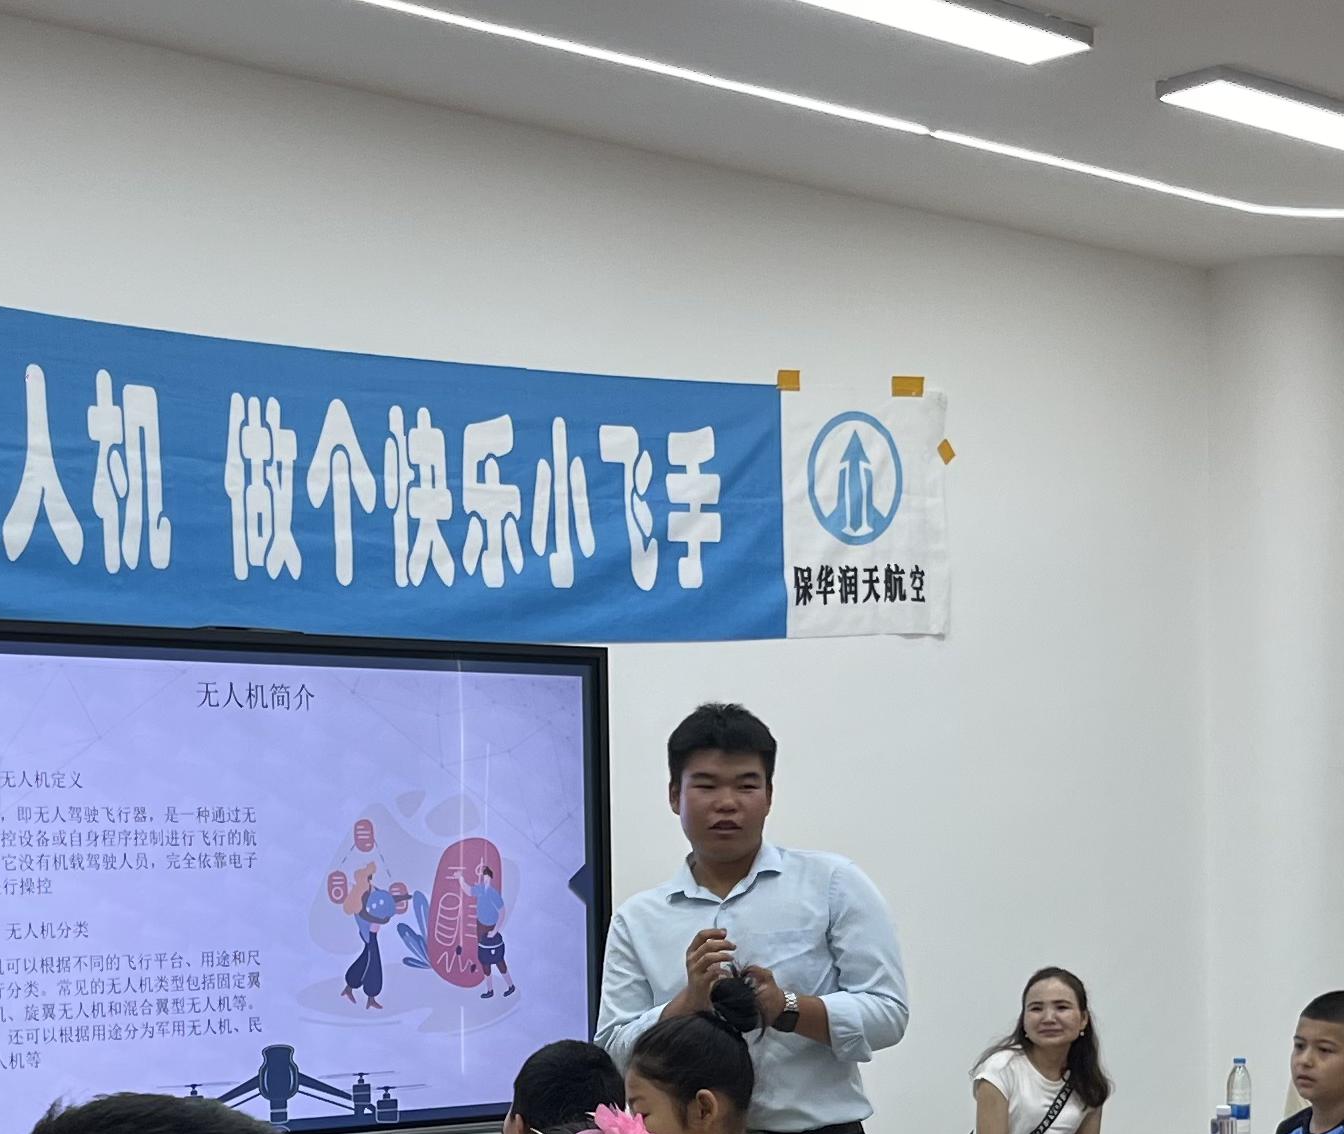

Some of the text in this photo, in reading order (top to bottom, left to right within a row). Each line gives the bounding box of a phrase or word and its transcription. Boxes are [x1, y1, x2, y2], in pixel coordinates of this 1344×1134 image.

[223, 391, 723, 592] 做个快乐小飞手
[793, 563, 926, 606] 保华润天航空
[196, 681, 316, 711] 无人机简介
